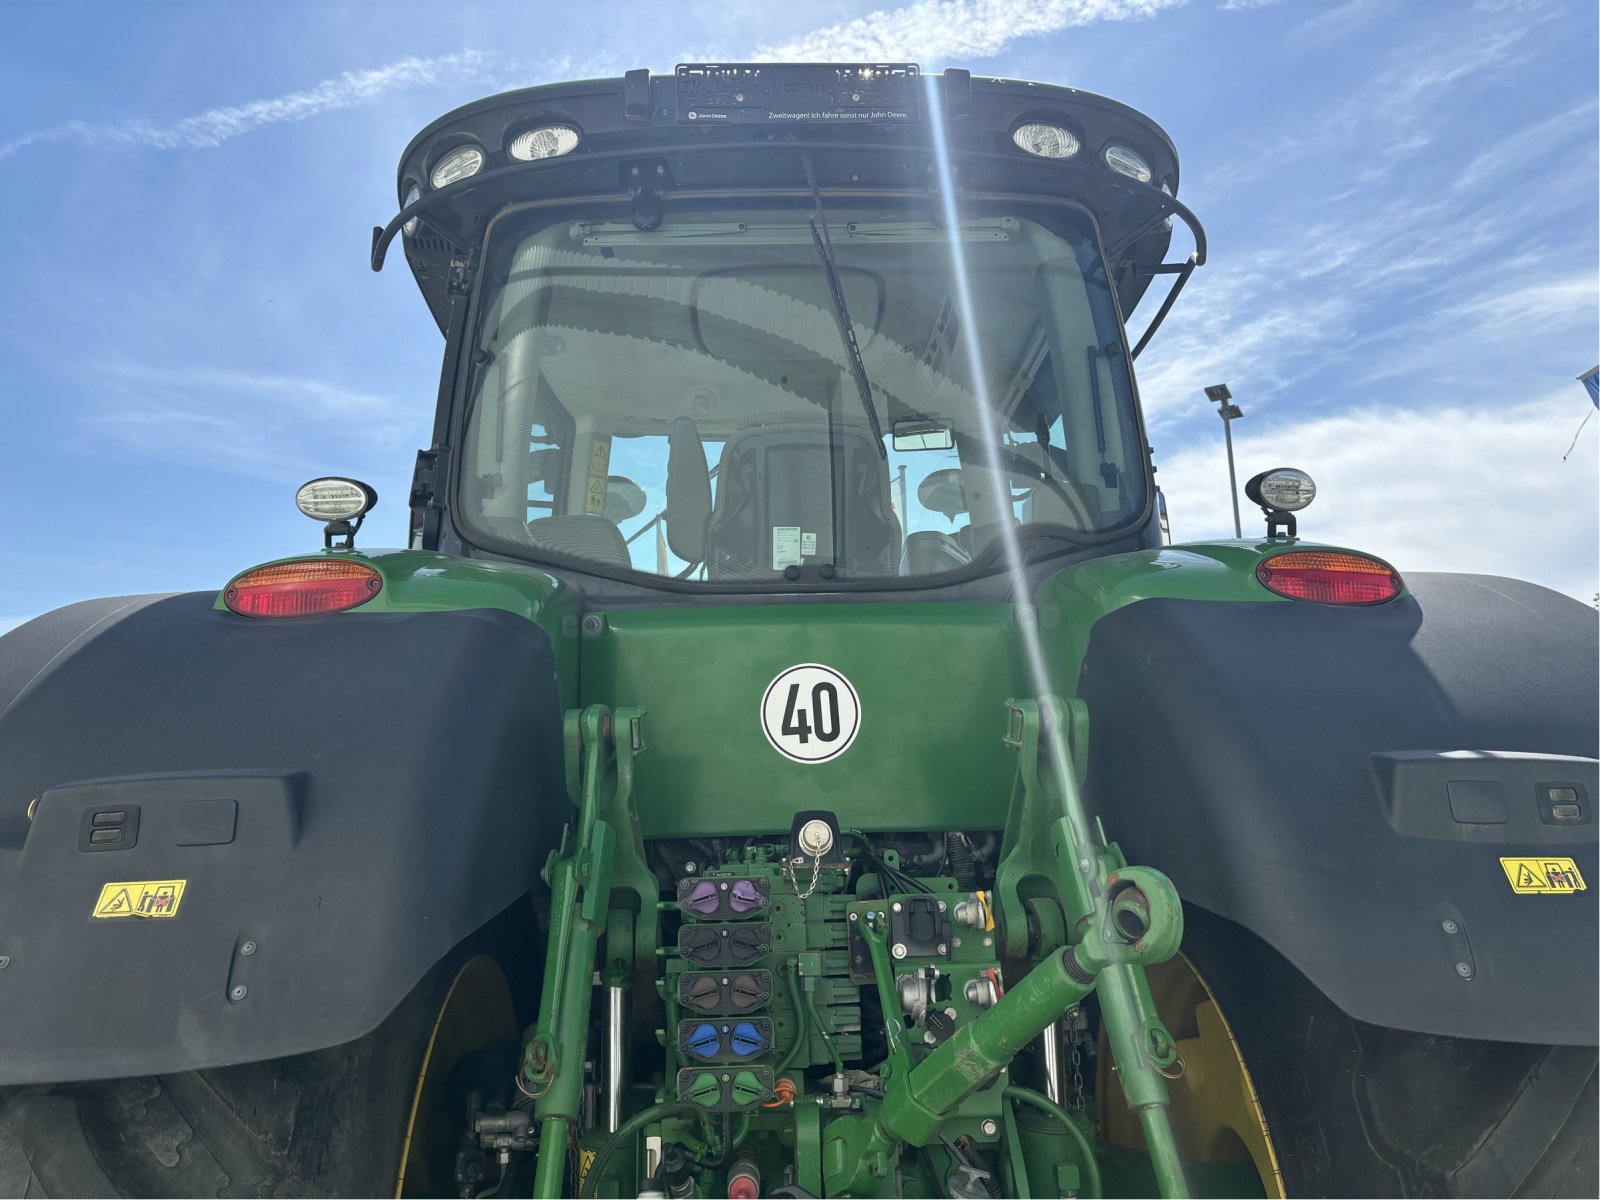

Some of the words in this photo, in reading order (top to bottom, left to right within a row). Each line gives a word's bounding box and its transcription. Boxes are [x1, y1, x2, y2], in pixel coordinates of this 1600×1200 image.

[768, 111, 810, 121] Zweitwagen!
[811, 111, 821, 119] Ich
[821, 111, 839, 119] fahre
[870, 111, 887, 119] John
[781, 681, 841, 744] 40
